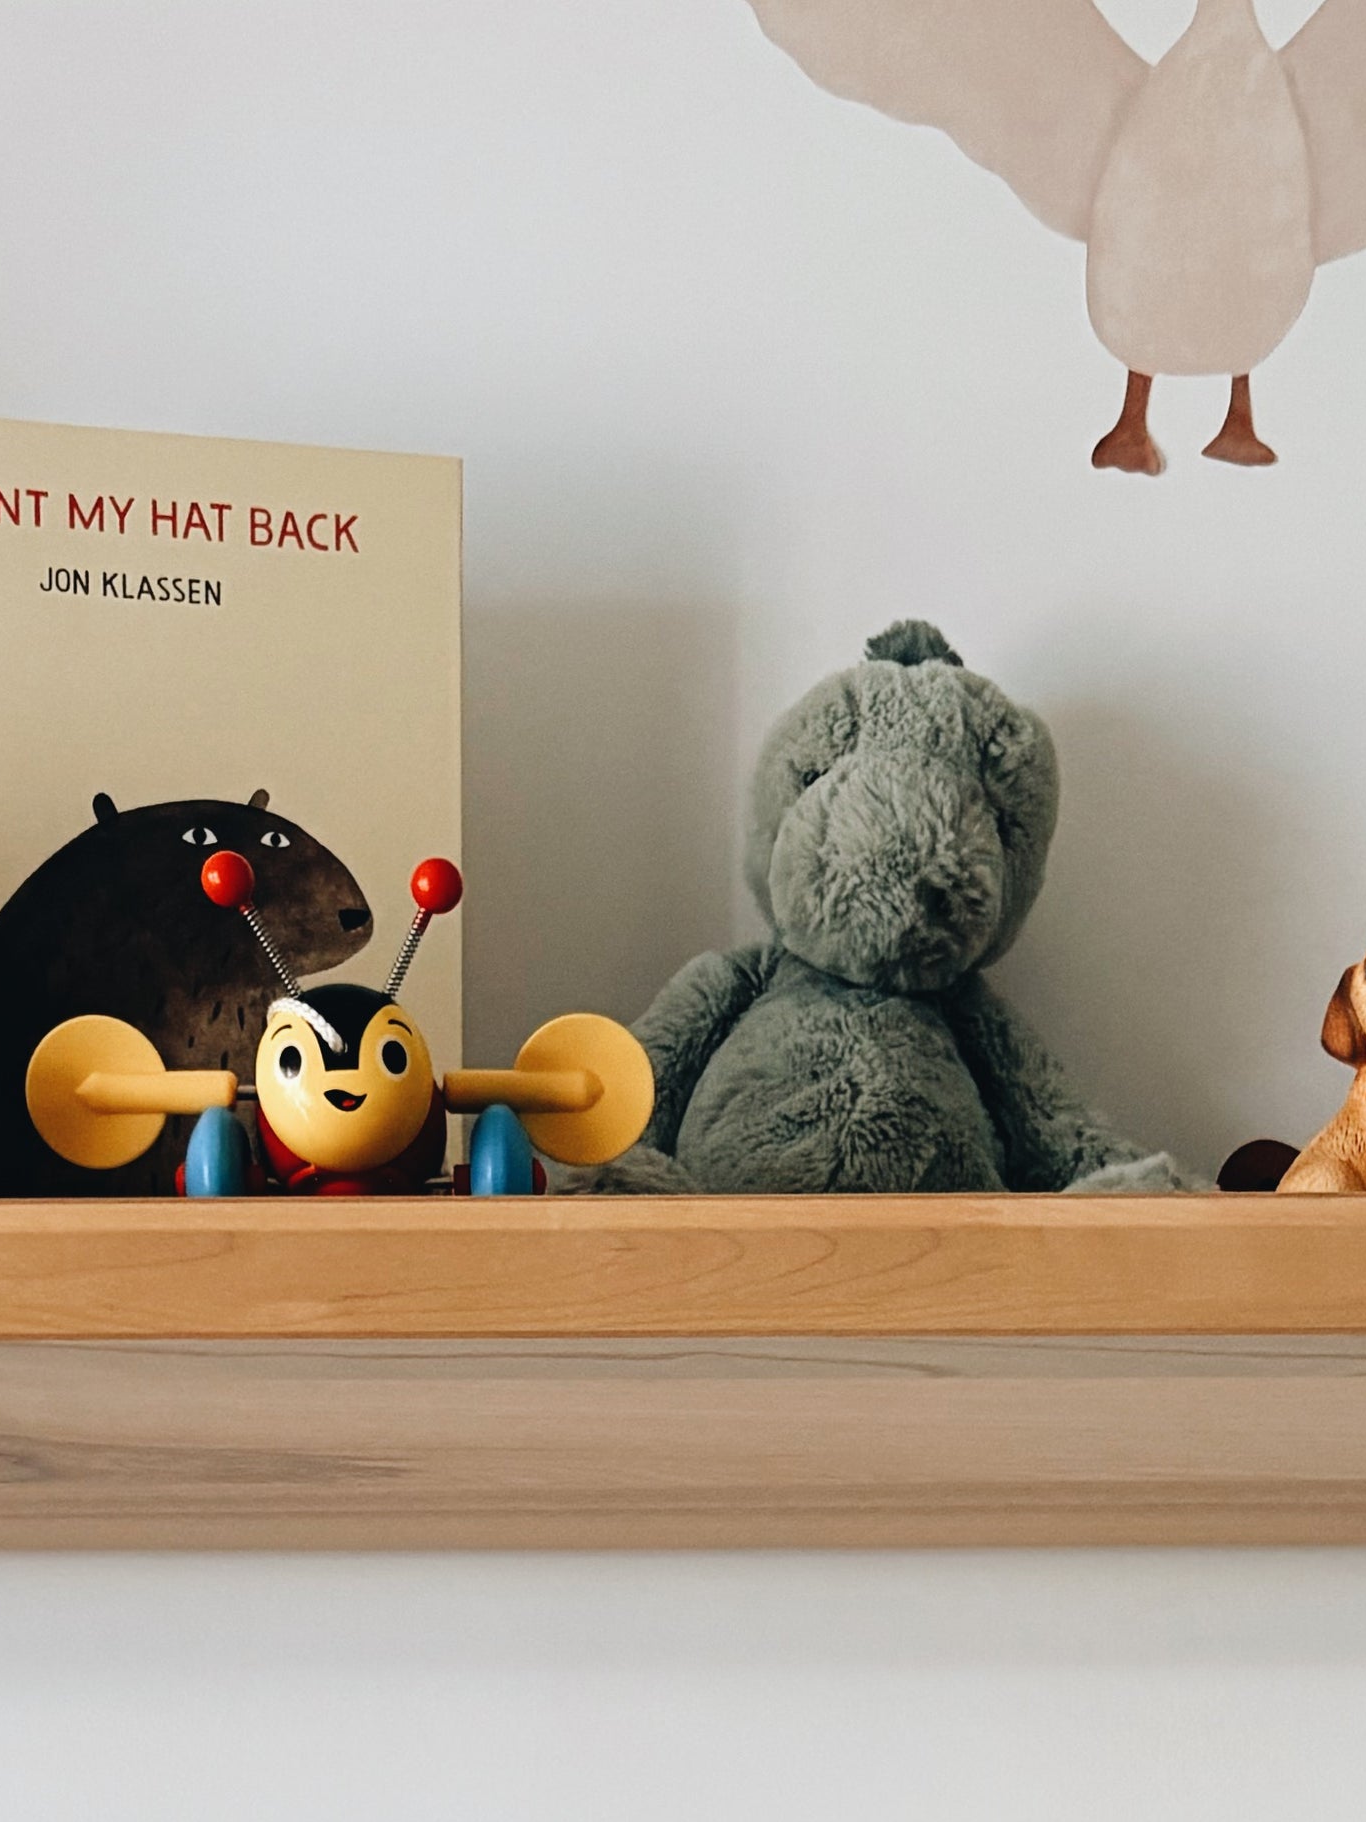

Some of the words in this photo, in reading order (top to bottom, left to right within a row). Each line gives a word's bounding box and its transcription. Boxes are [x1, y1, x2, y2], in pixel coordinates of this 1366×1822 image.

[67, 492, 136, 536] MY
[150, 497, 234, 544] HAT
[248, 507, 361, 554] BACK
[39, 566, 91, 597] JON
[101, 570, 223, 608] KLASSEN
